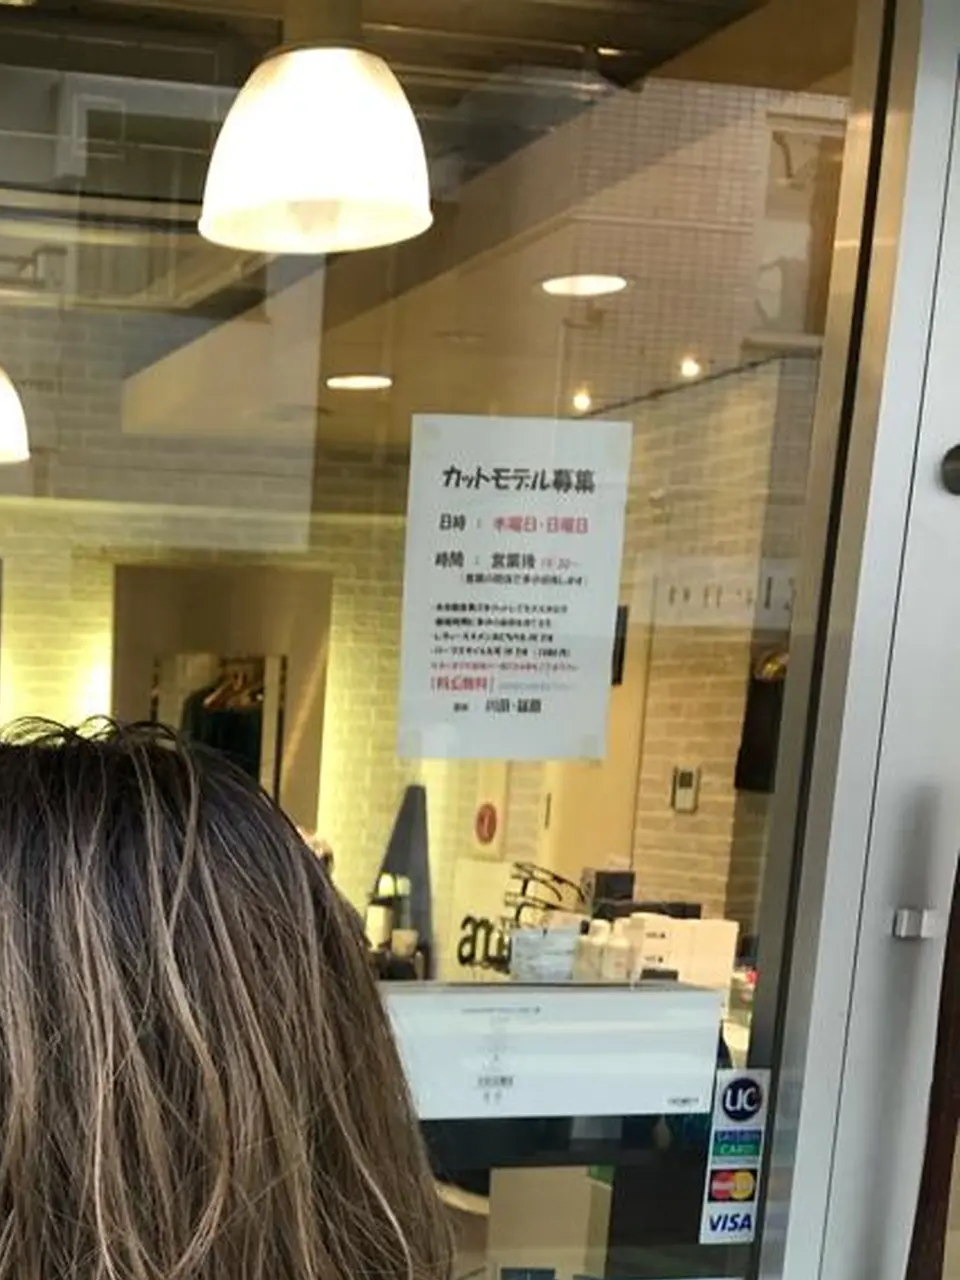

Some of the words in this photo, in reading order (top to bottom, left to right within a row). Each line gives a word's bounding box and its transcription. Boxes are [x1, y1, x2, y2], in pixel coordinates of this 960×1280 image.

[443, 464, 596, 494] カットモデル募集
[725, 1087, 758, 1112] UC
[709, 1213, 753, 1232] VISA
